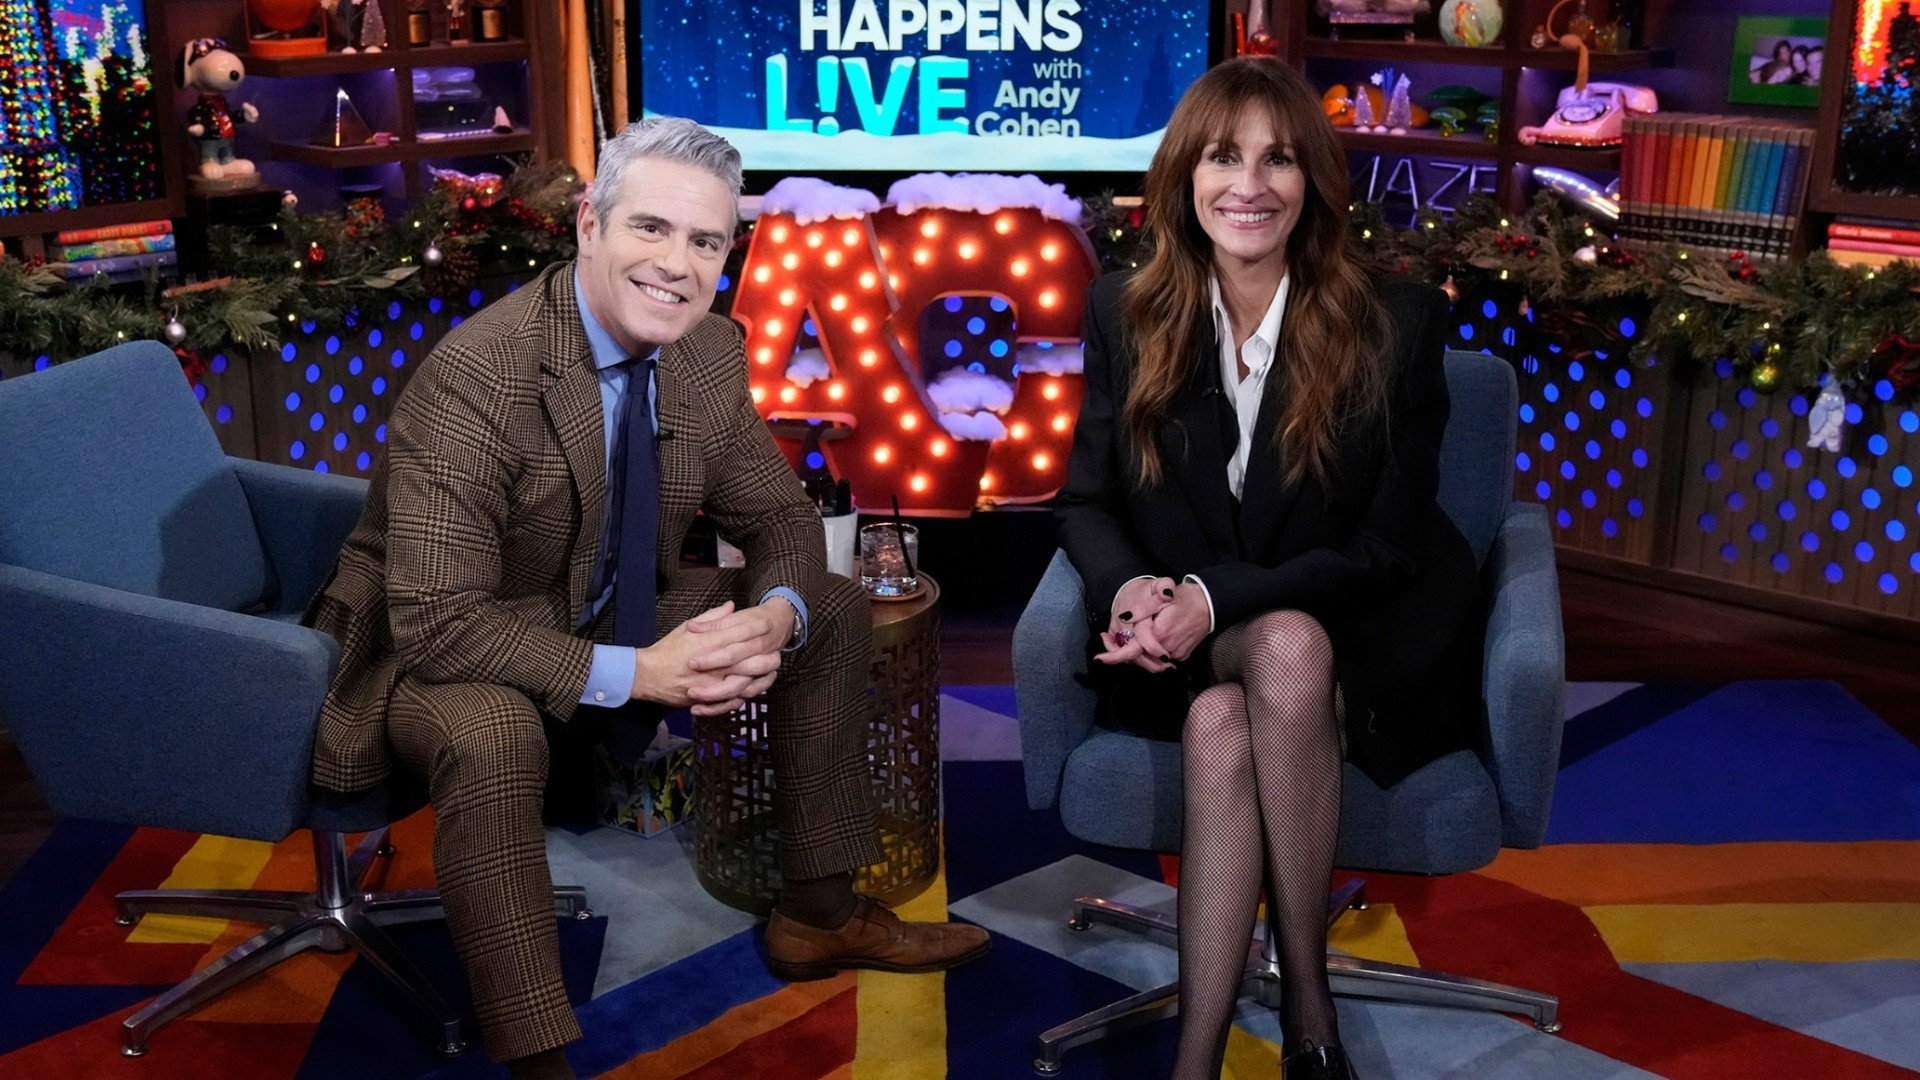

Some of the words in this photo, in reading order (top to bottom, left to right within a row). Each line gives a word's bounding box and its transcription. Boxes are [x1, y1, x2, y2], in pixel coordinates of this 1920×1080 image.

[800, 0, 1083, 51] HAPPENS
[1033, 58, 1082, 79] with
[766, 54, 969, 137] L!VE
[994, 80, 1081, 115] Andy
[975, 111, 1081, 138] Cohen
